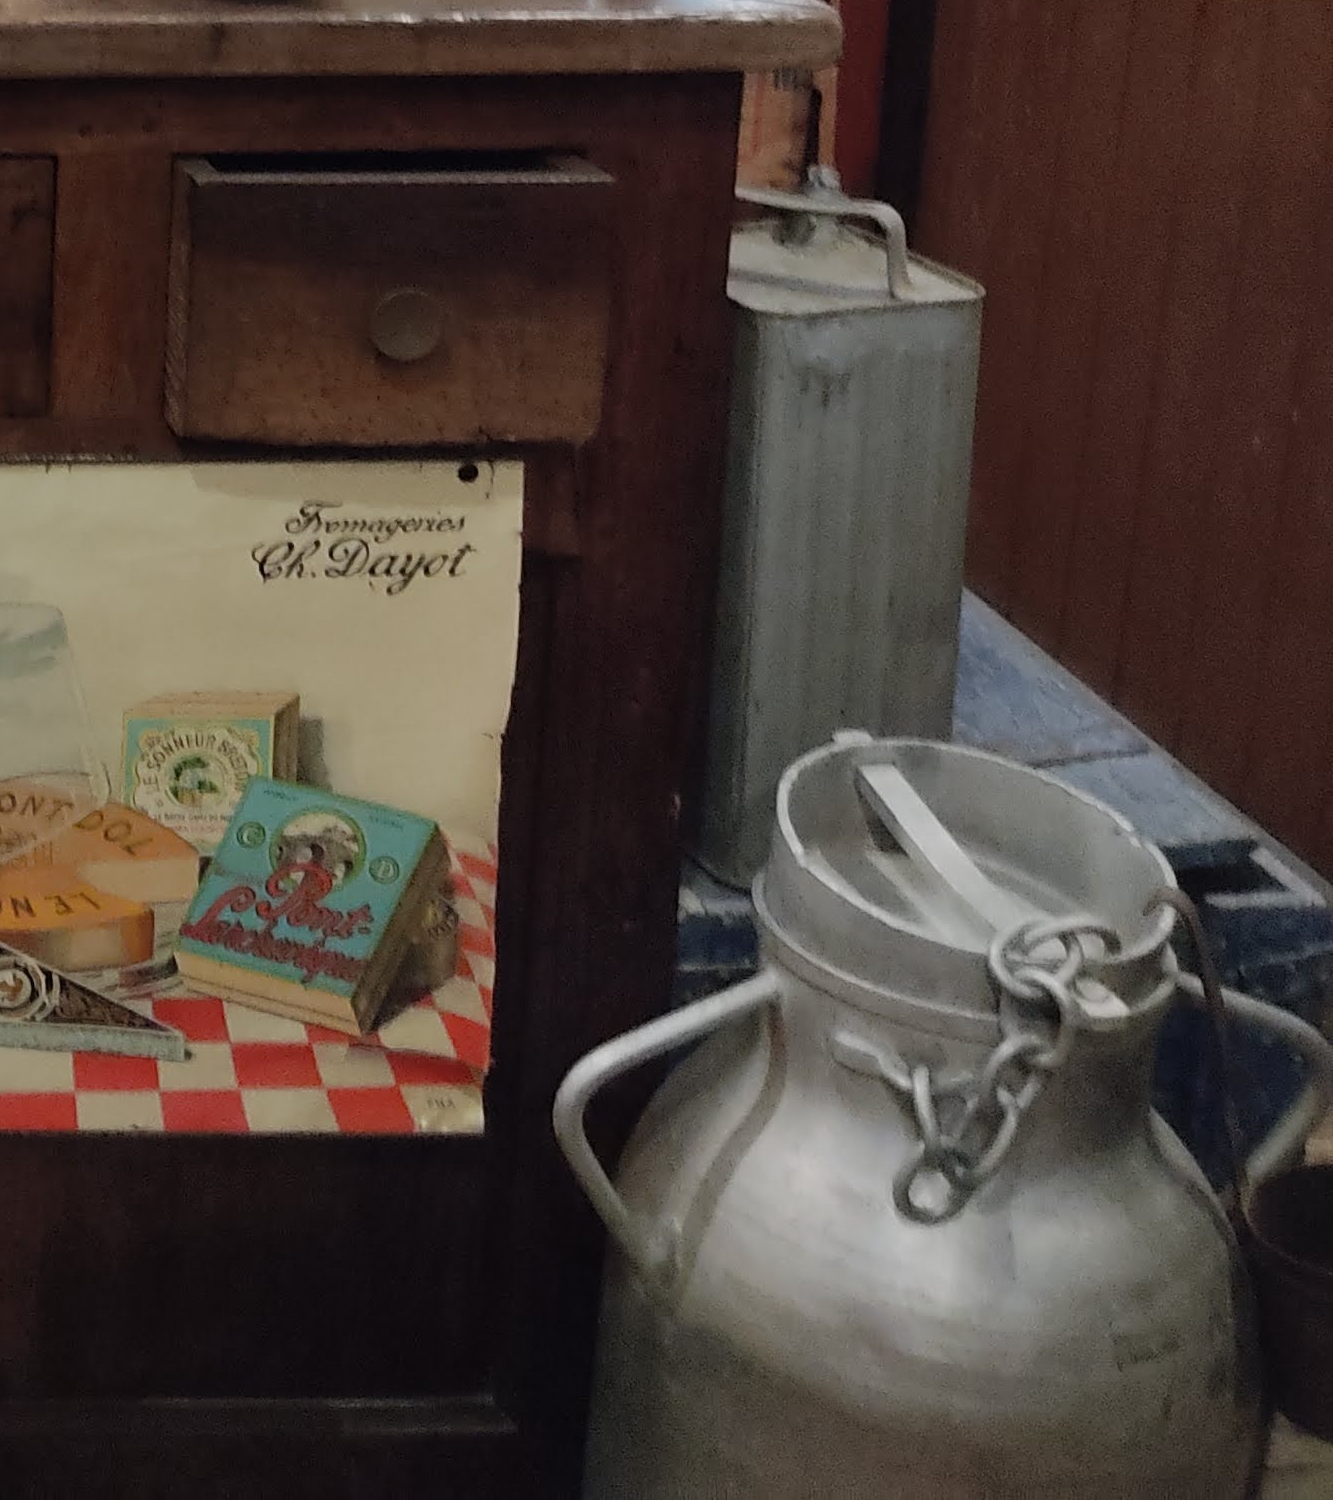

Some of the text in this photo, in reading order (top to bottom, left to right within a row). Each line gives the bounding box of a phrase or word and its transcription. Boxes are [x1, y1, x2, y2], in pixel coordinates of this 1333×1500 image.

[285, 499, 466, 544] Fromageries
[251, 536, 478, 596] Ch. Dayot
